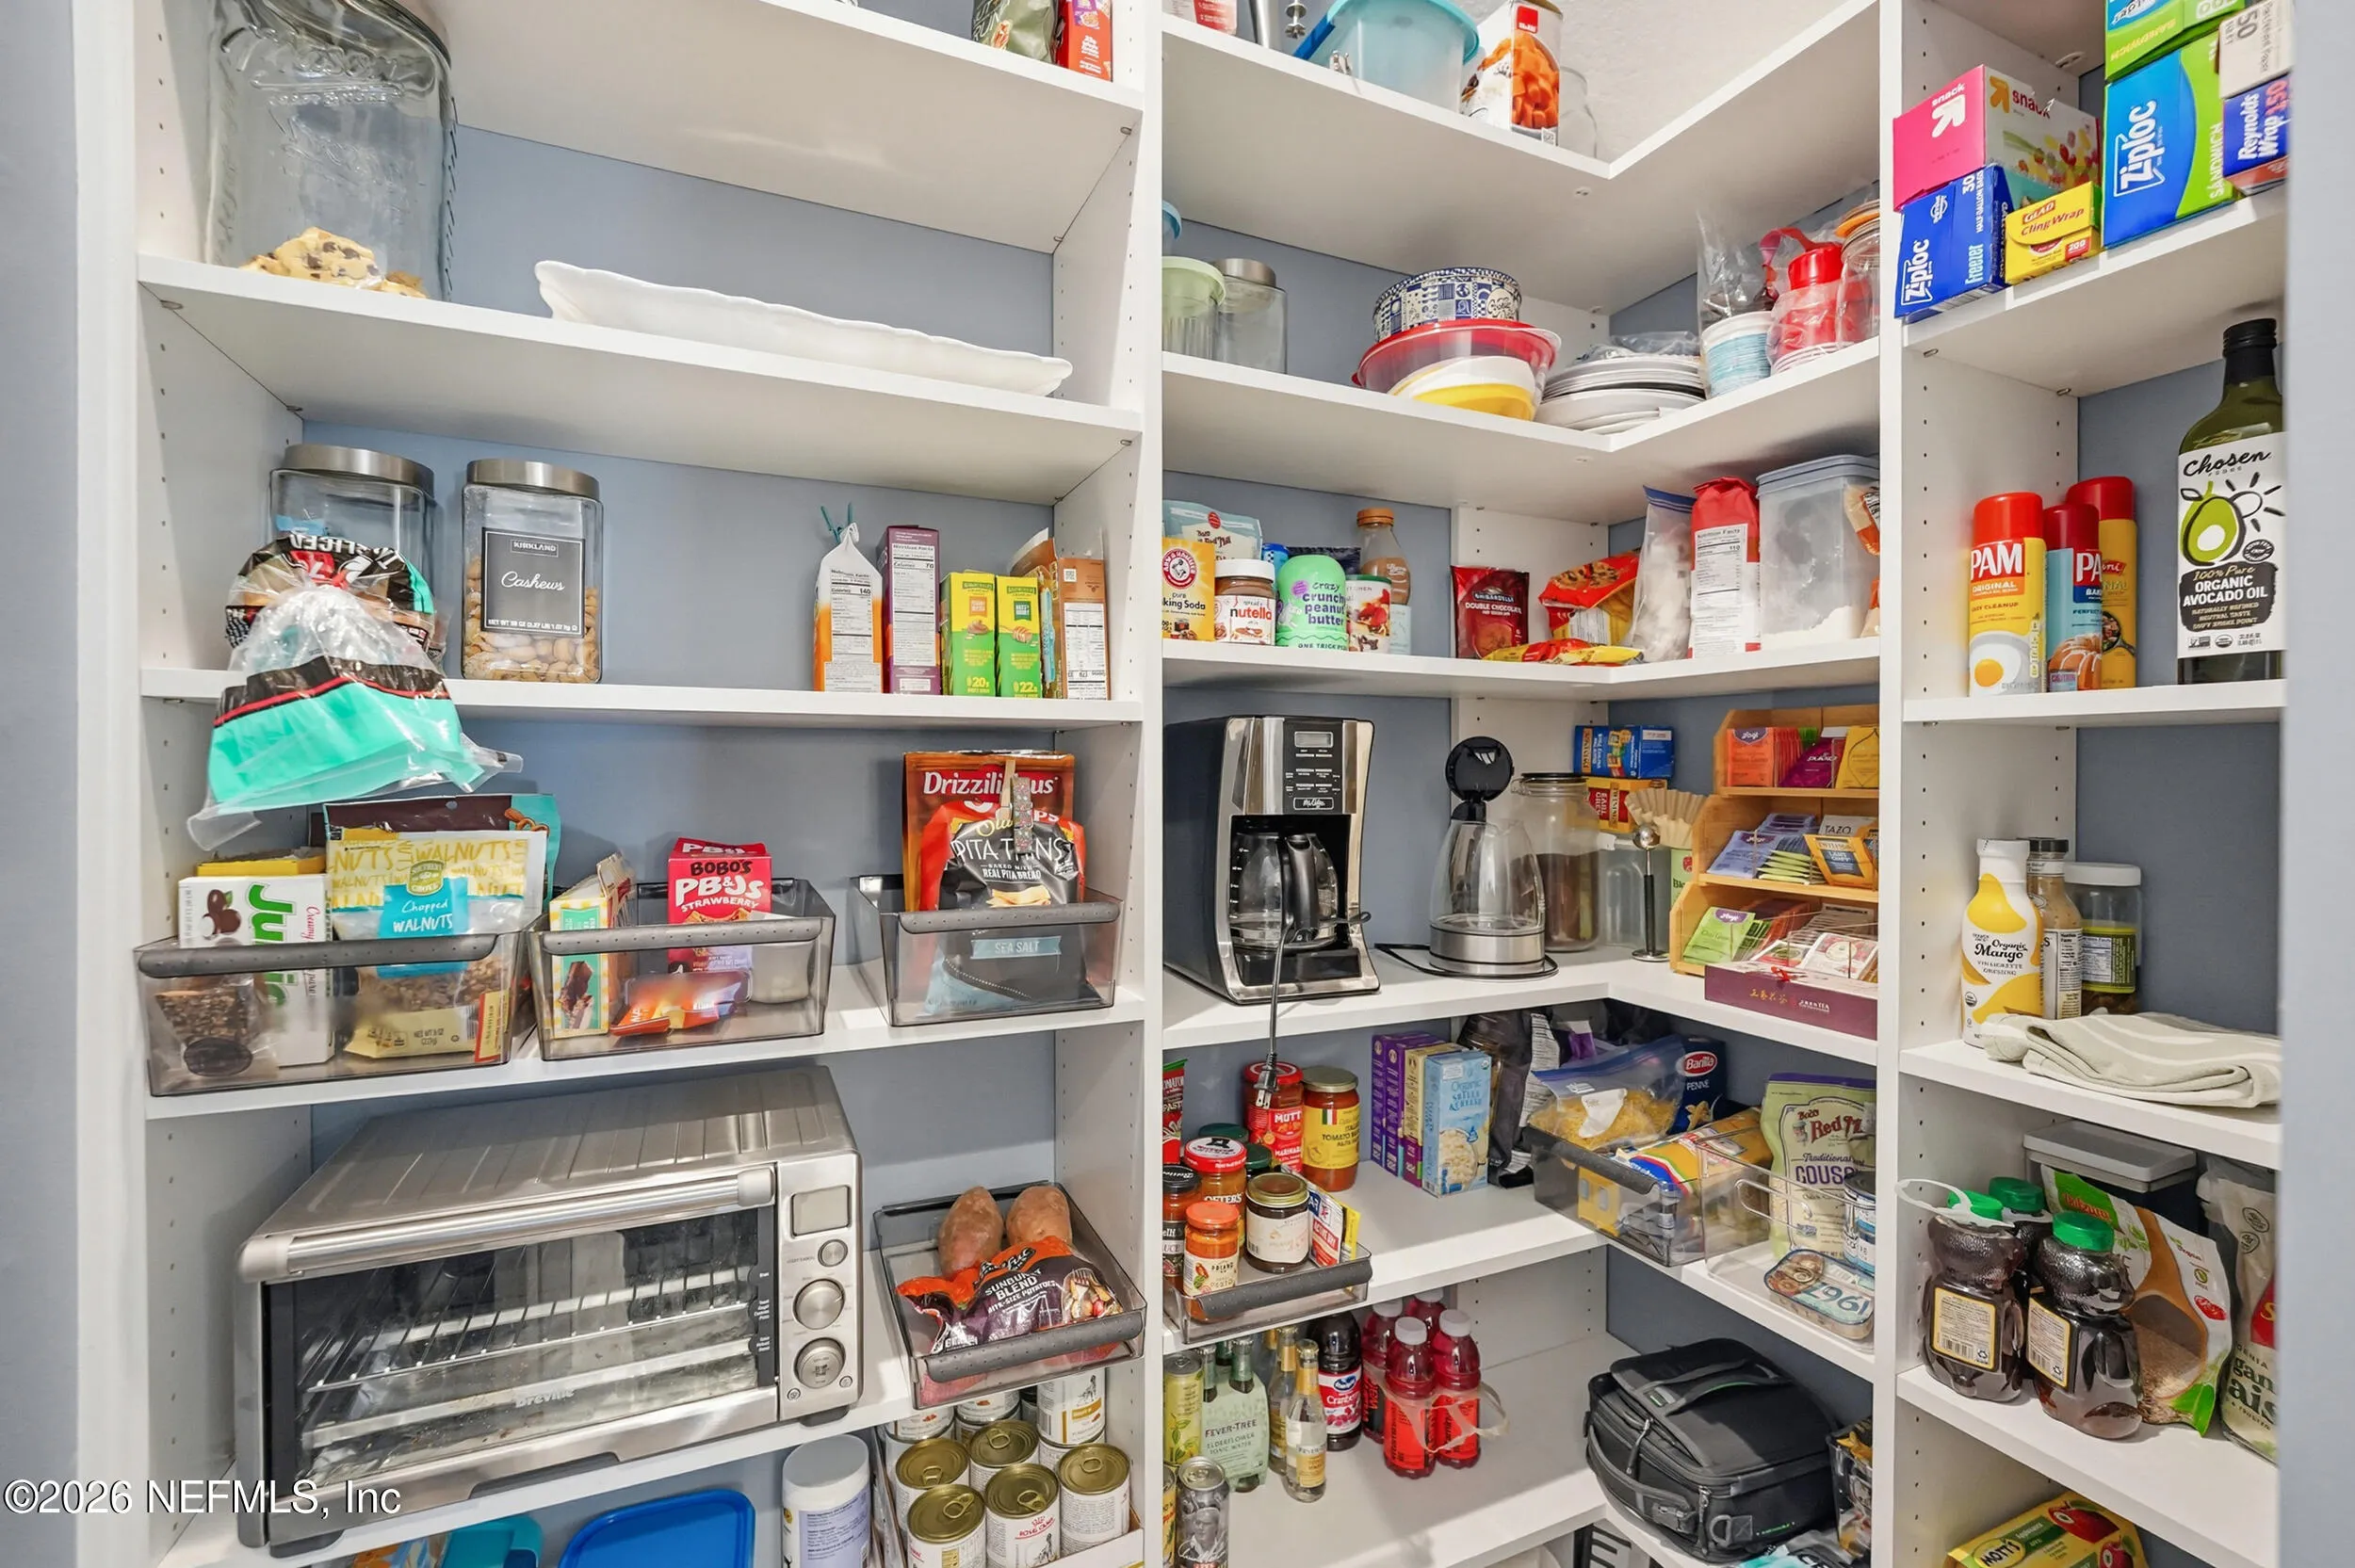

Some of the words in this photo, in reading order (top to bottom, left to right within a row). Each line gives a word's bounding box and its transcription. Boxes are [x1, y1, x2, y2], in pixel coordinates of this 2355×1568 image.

[2237, 9, 2258, 39] 50
[1932, 83, 1965, 105] snack
[2238, 93, 2260, 160] Reynolds
[2258, 115, 2291, 158] Wrap
[2120, 100, 2165, 190] Ziploc
[2209, 121, 2224, 199] SANDWICH
[1962, 173, 1975, 195] 30
[2022, 219, 2051, 235] Cling
[2053, 208, 2085, 224] Wrap
[2023, 202, 2055, 223] GLAD
[1905, 238, 1934, 302] Ziploc
[1965, 244, 1984, 284] Freezer
[2184, 452, 2271, 477] Chosen
[513, 542, 557, 552] KIRKLAND
[1970, 543, 2022, 580] PAM
[2076, 553, 2102, 582] PA
[501, 571, 565, 591] Cashews
[2193, 570, 2224, 581] 100%
[2225, 565, 2256, 577] Pure
[2195, 574, 2253, 592] ORGANIC
[1312, 582, 1340, 592] crazy
[1973, 581, 2017, 593] ORIGINAL
[2183, 589, 2244, 607] AVOCADO
[2246, 586, 2268, 599] OIL
[1162, 597, 1182, 610] king
[1184, 600, 1206, 610] Soda
[1230, 606, 1273, 621] nutella
[1305, 604, 1345, 615] peanut
[1308, 614, 1344, 626] butter
[923, 771, 1055, 796] Drizzilius
[1825, 825, 1851, 834] TAZO
[950, 839, 999, 864] PITA
[1000, 837, 1063, 862] TNS
[690, 860, 753, 876] BOBO'S
[983, 868, 1000, 878] REAL
[401, 899, 448, 913] Chopped
[680, 897, 759, 913] STRAWBERRY
[393, 913, 453, 932] WALNUTS
[995, 942, 1014, 954] SEA
[1015, 941, 1039, 953] SALT
[1973, 943, 2023, 962] Mango
[1991, 940, 2027, 951] Organic
[1686, 1056, 1715, 1071] Barilla
[1275, 1110, 1302, 1123] MUTT
[1810, 1115, 1842, 1143] Red
[1803, 1153, 1853, 1163] Traditional
[996, 1276, 1038, 1301] BLEND
[1205, 1418, 1258, 1438] FEVER-TREE
[1980, 1539, 2021, 1566] MOTT'S
